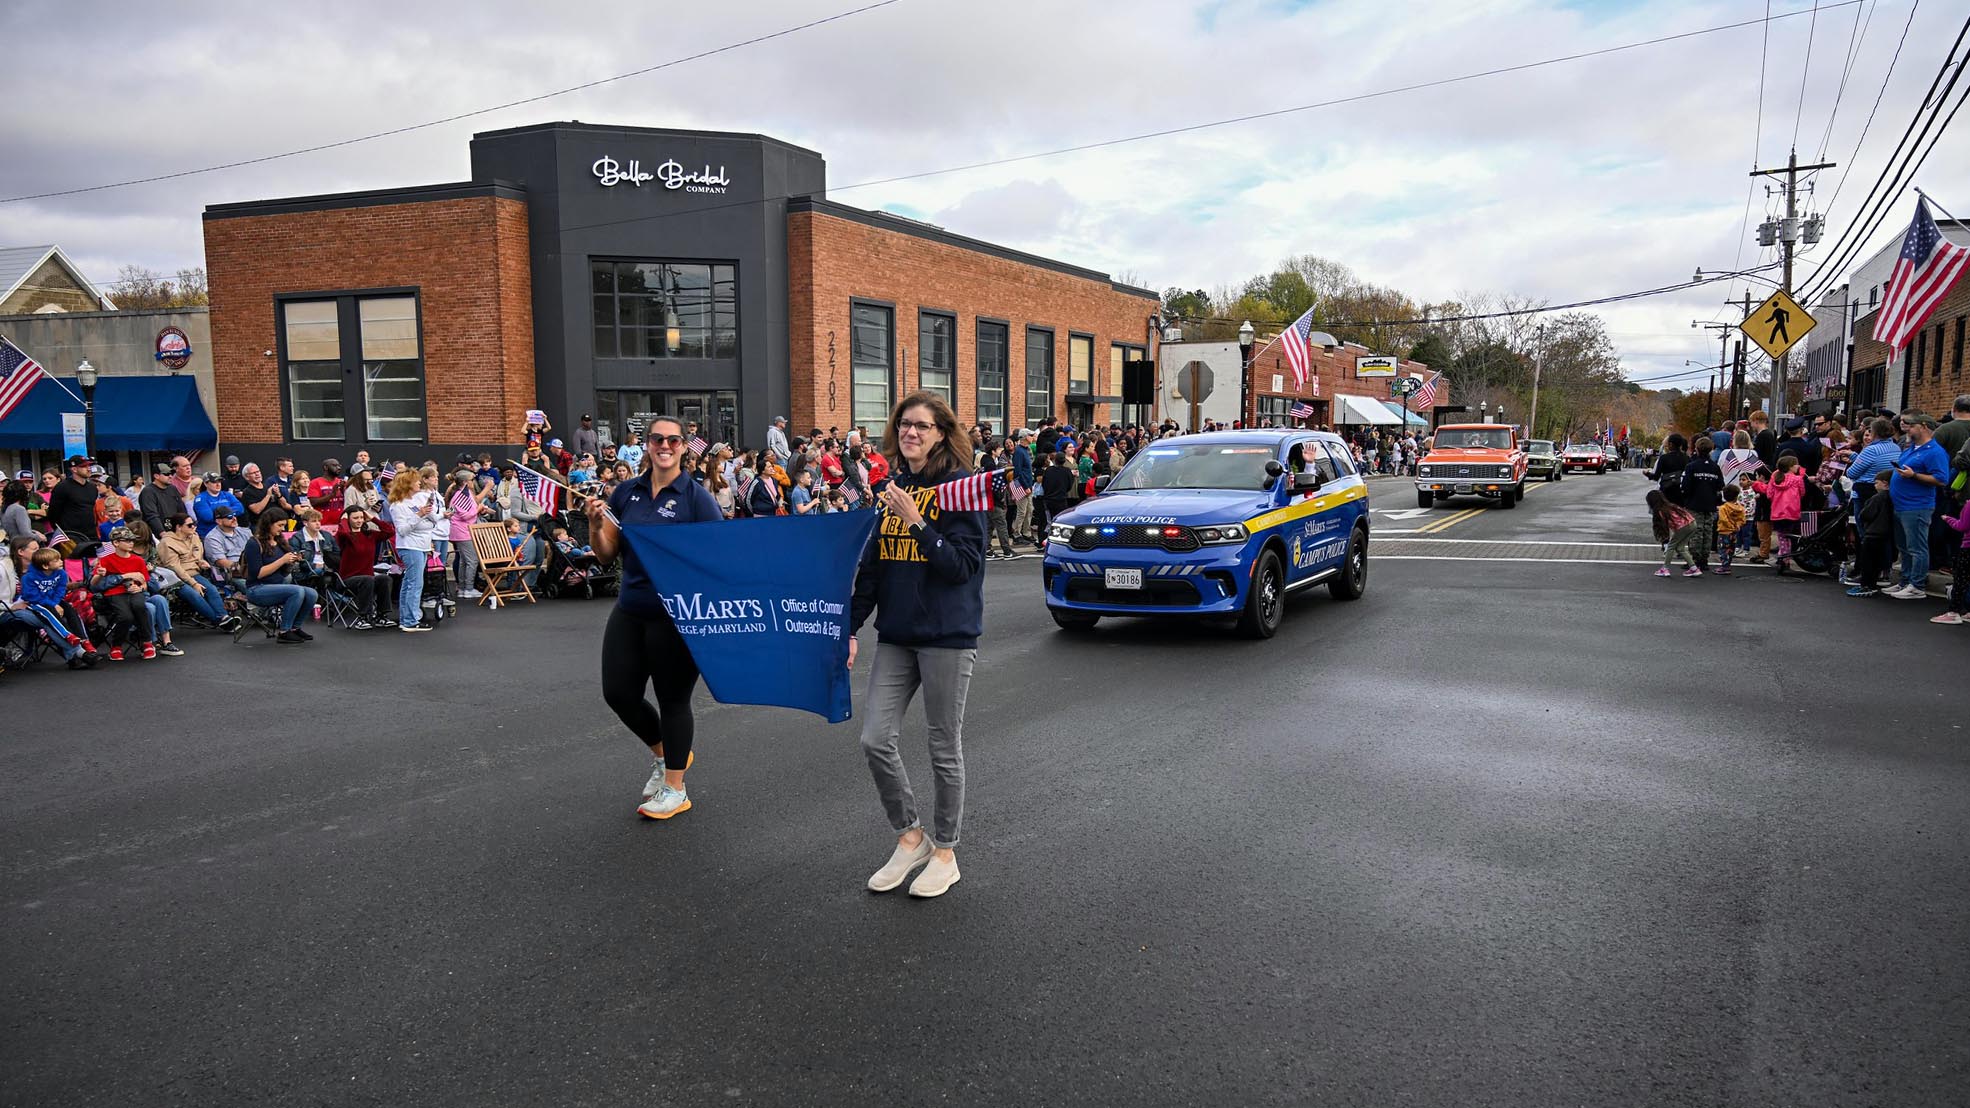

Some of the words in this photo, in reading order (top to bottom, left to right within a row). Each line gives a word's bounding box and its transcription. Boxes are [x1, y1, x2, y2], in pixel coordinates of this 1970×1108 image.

[592, 155, 654, 187] Bella
[657, 158, 730, 190] Bridal
[686, 185, 727, 194] COMPANY
[828, 331, 836, 411] 22700
[1091, 516, 1134, 525] CAMPUS
[1135, 516, 1177, 525] POLICE
[1298, 546, 1327, 569] CAMPUS
[1325, 540, 1347, 560] POLICE
[1116, 574, 1140, 585] 30186
[674, 593, 764, 620] MARY'S
[781, 599, 808, 613] Office
[809, 599, 818, 613] of
[699, 624, 708, 637] of
[708, 623, 767, 634] MARYLAND
[785, 619, 822, 634] Outreach
[822, 621, 832, 635] &
